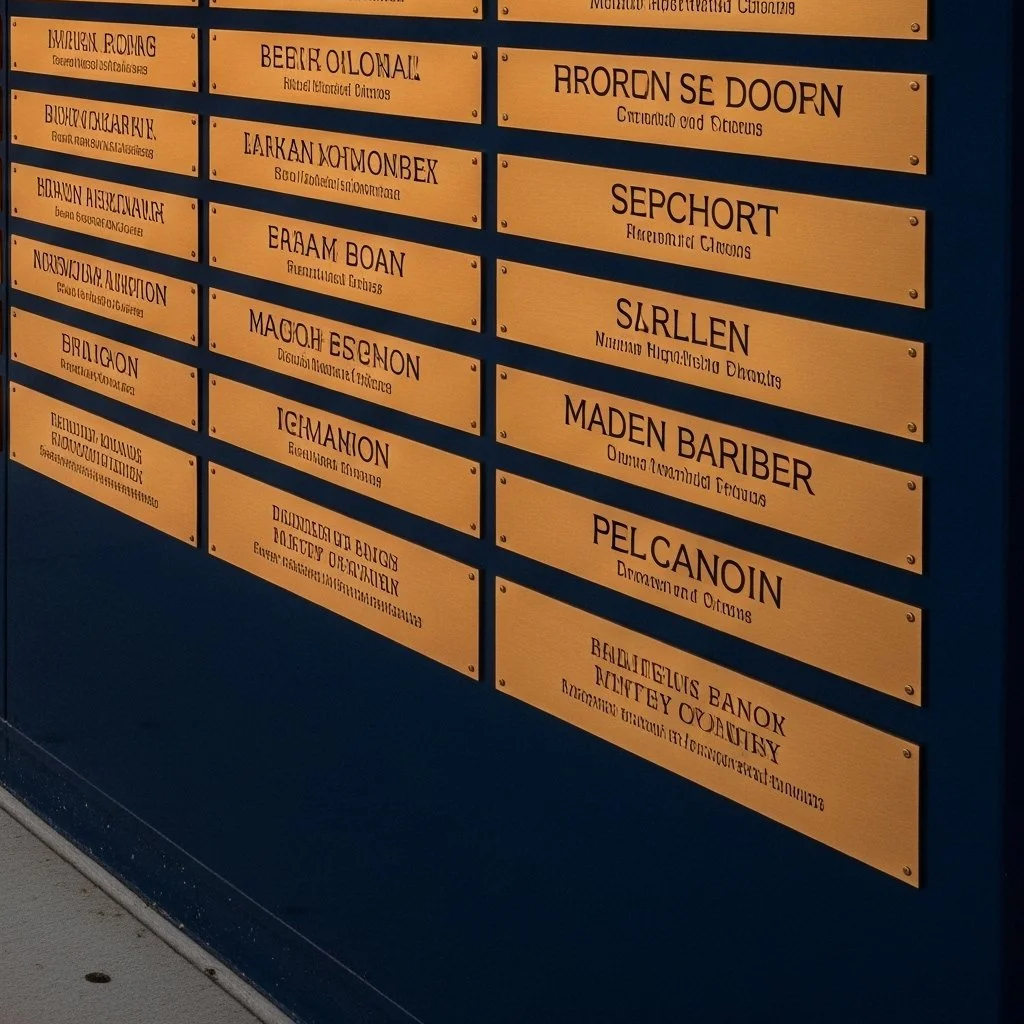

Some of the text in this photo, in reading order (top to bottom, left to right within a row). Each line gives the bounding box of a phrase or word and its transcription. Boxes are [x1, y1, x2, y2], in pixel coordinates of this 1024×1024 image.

[680, 72, 715, 106] SE
[611, 183, 779, 237] SEPCHORT
[346, 241, 406, 278] BOAN
[564, 394, 667, 452] MADEN
[678, 425, 815, 496] BARIBER
